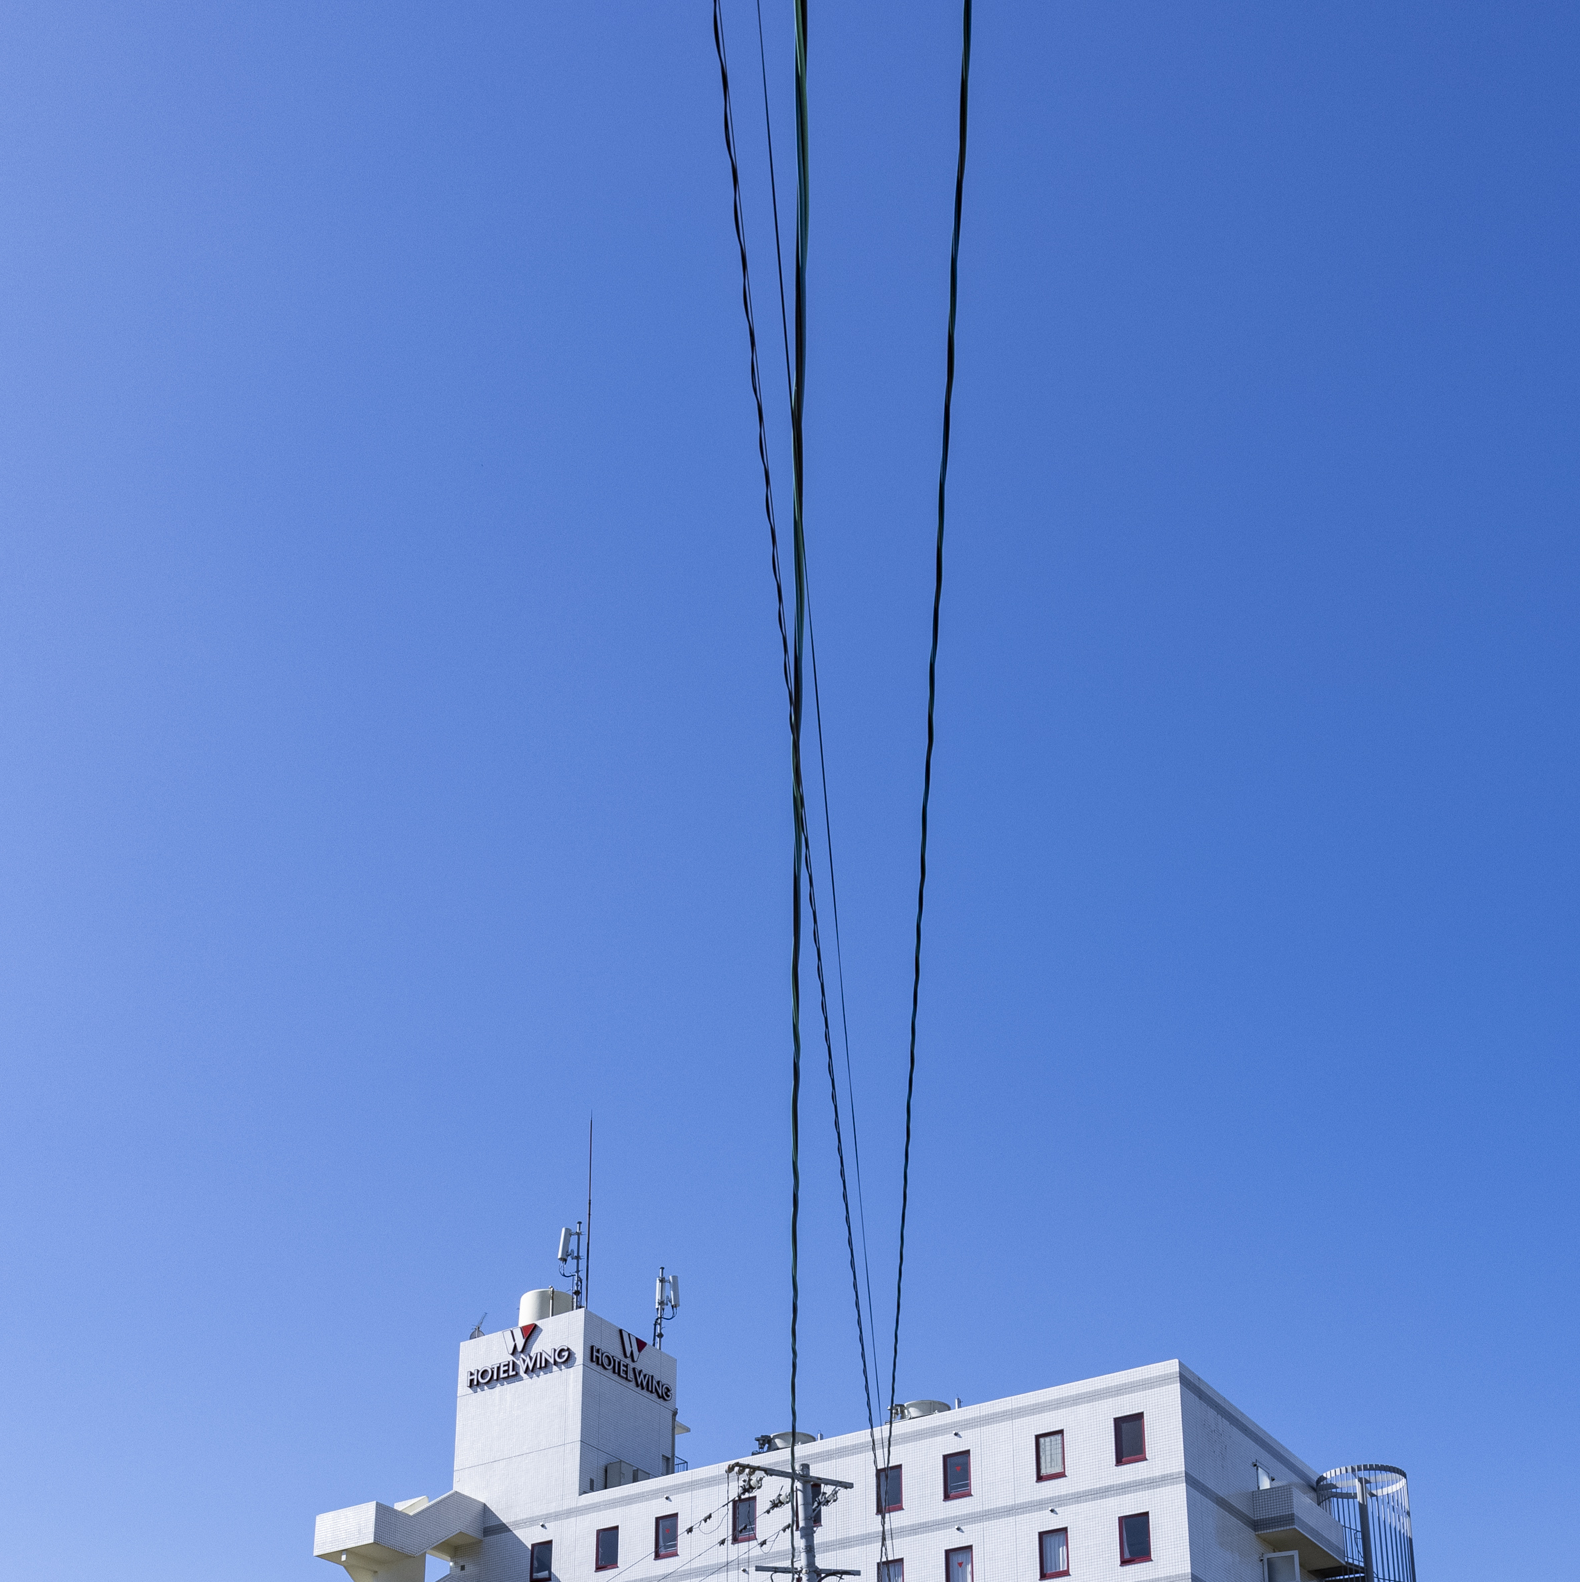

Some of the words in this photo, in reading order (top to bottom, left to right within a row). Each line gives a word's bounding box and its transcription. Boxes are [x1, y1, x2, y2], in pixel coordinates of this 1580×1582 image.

[466, 1359, 517, 1388] HOTEL
[519, 1344, 571, 1374] WING
[590, 1345, 633, 1382] HOTEL
[632, 1366, 672, 1401] WING
